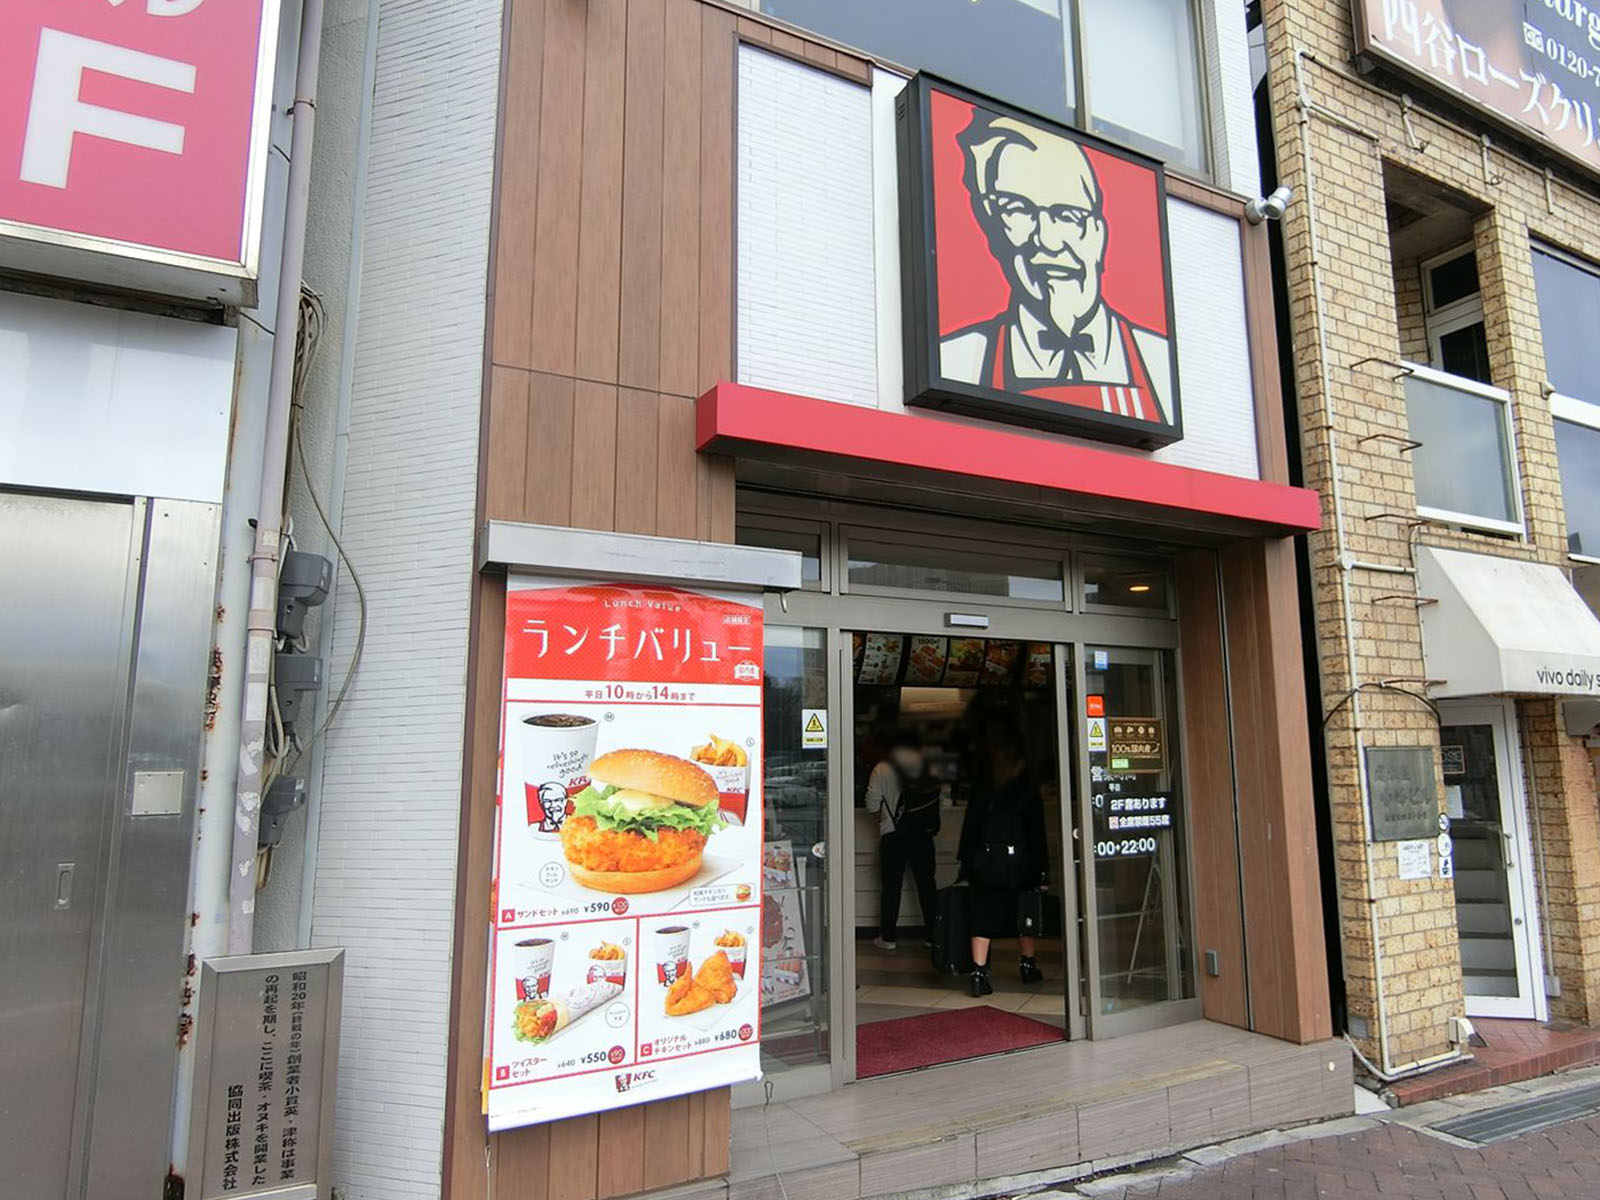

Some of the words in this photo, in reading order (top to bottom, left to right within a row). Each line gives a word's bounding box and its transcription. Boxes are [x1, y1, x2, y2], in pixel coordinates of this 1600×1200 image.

[1384, 0, 1600, 147] 四谷ローズクリ
[20, 27, 197, 190] F
[604, 599, 642, 608] Lunch
[647, 600, 682, 613] Value
[522, 619, 752, 664] ランチバリュー
[1536, 666, 1564, 685] vivo
[1566, 669, 1594, 690] daily
[584, 684, 696, 701] 平日10時から14時まで
[559, 763, 583, 778] good
[517, 908, 558, 919] サンドセット
[584, 901, 610, 913] ¥590
[654, 1034, 688, 1046] オリジナル
[715, 1028, 737, 1041] ¥680
[654, 1043, 692, 1055] チキンセット
[511, 1057, 548, 1069] ツイスター
[581, 1051, 607, 1064] ¥550
[511, 1068, 531, 1079] セット
[633, 1069, 656, 1082] KFC
[222, 1084, 244, 1191] 協同出版株式会社
